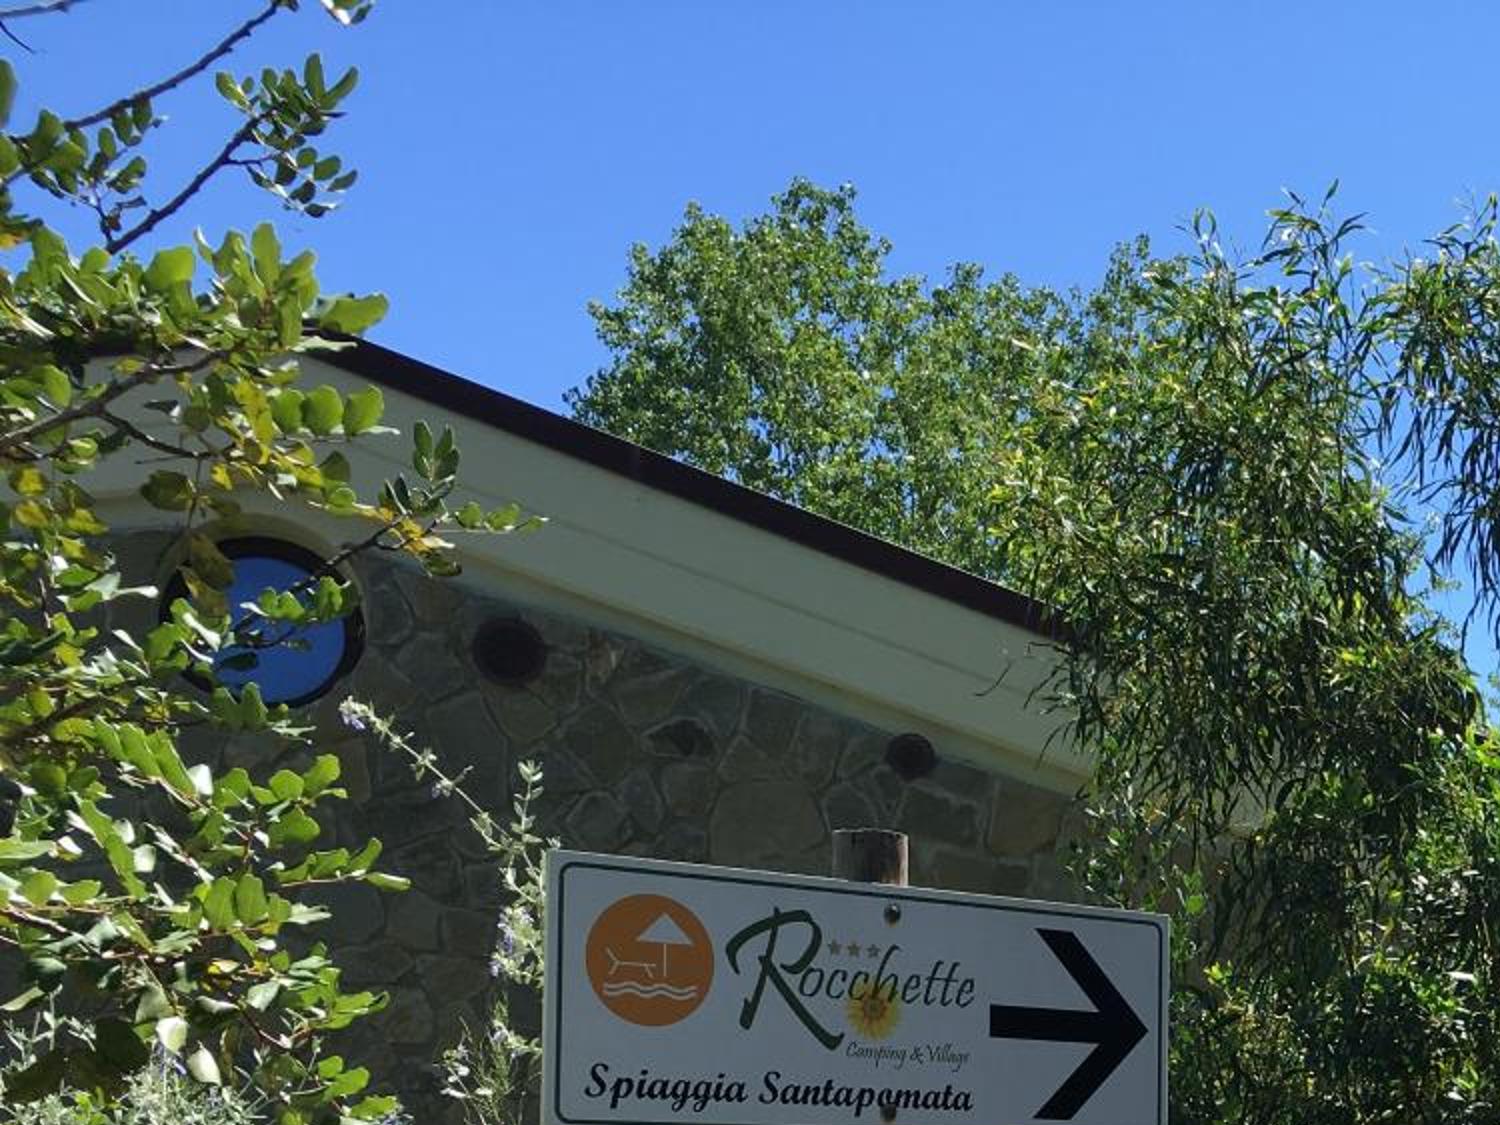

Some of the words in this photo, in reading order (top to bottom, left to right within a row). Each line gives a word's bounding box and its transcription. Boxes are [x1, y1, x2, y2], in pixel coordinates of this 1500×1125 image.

[725, 906, 975, 1050] Rocchette
[845, 1040, 909, 1070] Camping
[910, 1044, 926, 1064] &
[927, 1043, 971, 1073] Village
[584, 1064, 748, 1112] Spiaggia
[758, 1071, 974, 1117] Santapomata
